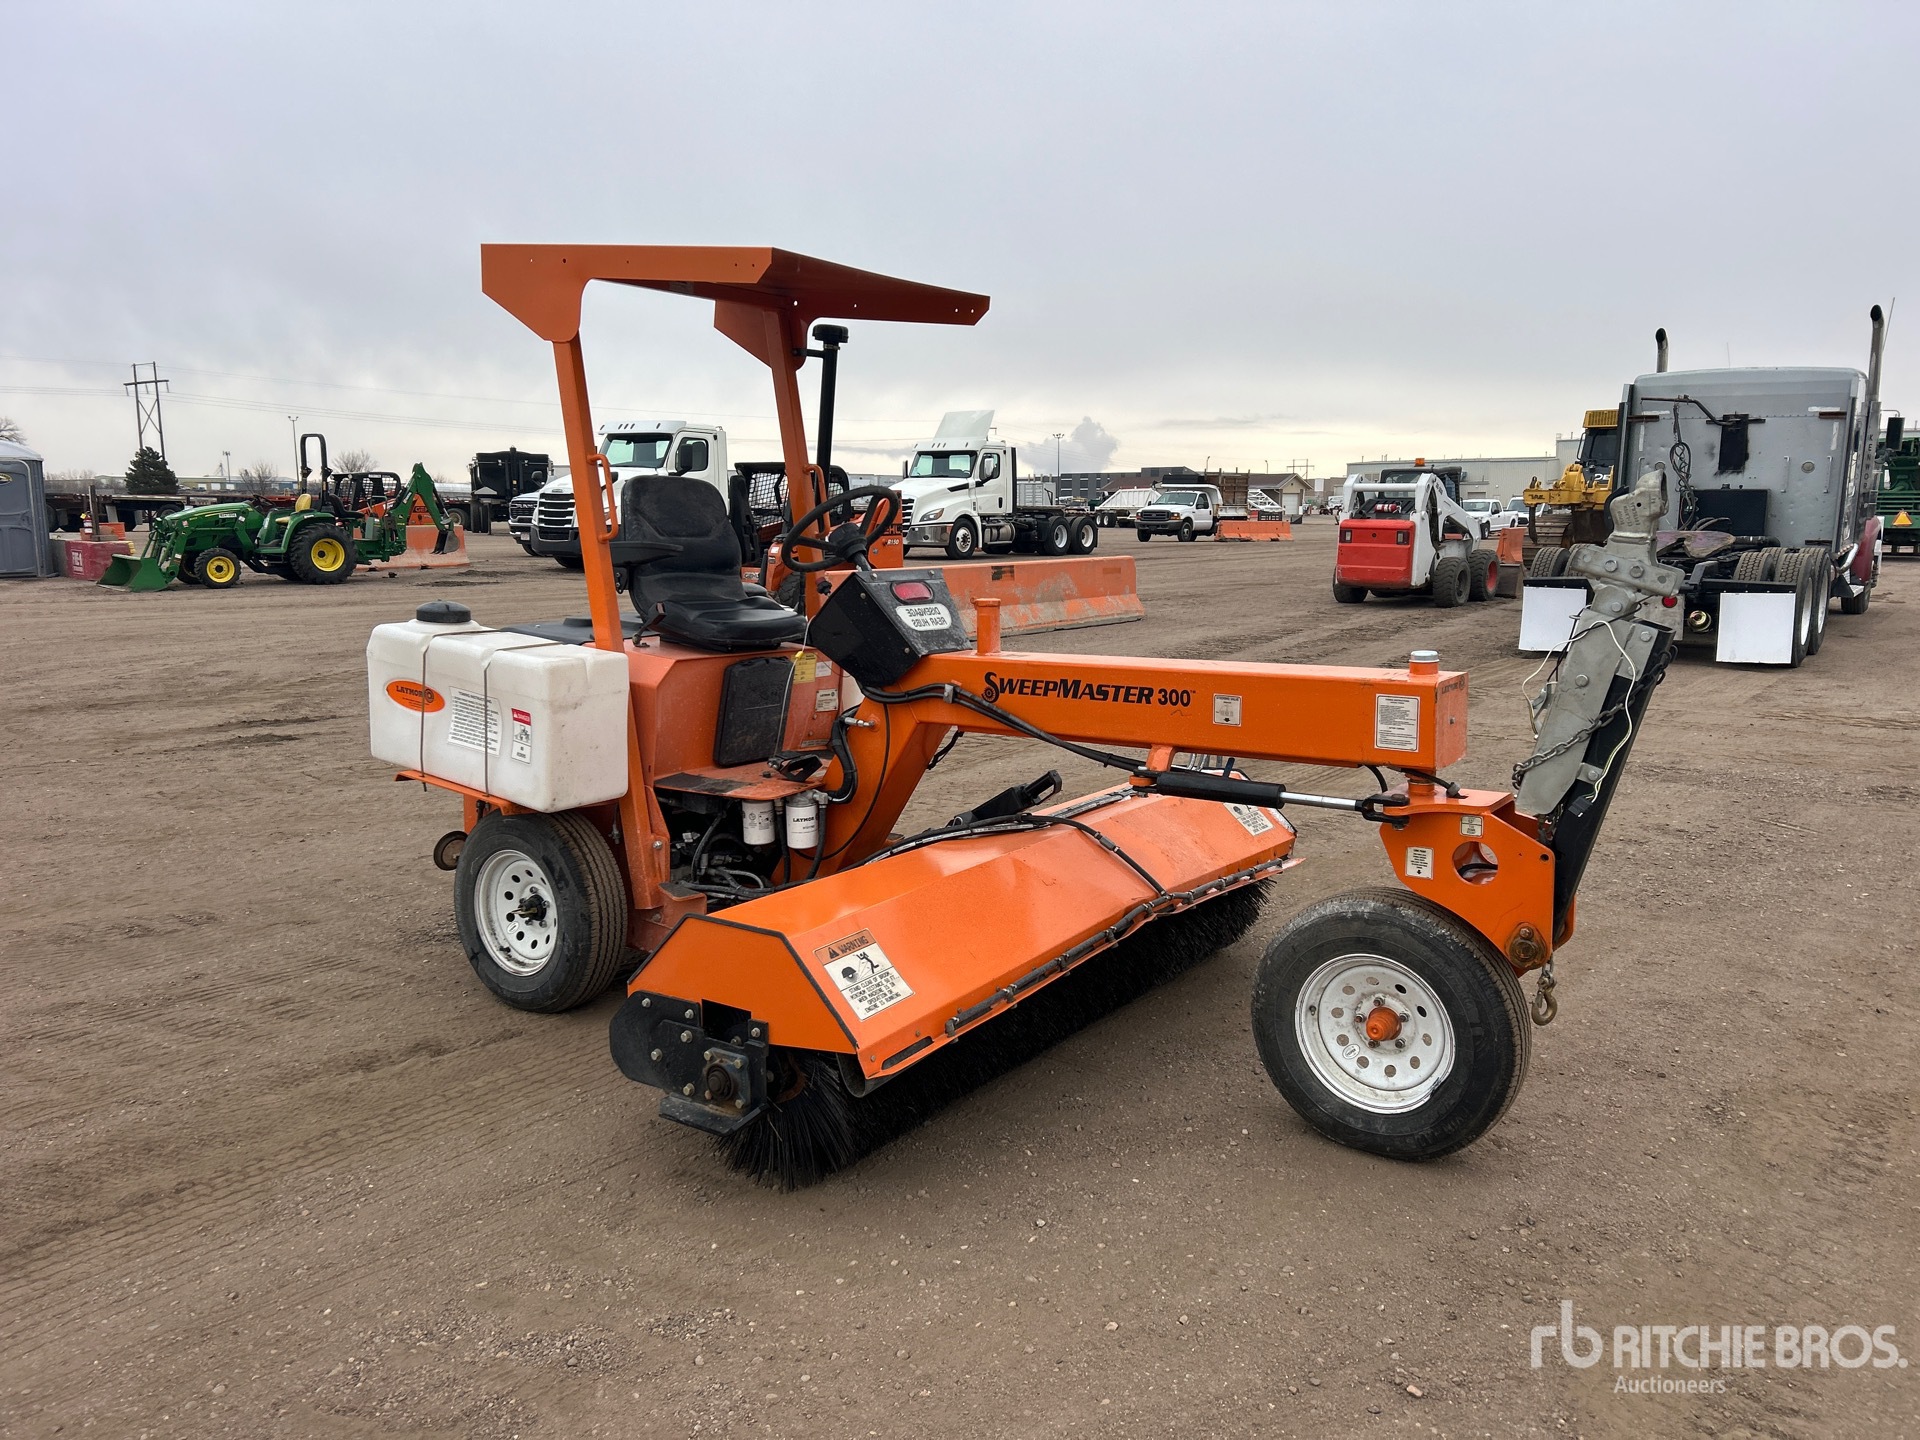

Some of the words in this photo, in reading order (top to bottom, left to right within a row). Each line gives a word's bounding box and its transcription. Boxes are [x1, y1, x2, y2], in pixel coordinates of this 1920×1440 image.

[1863, 434, 1874, 490] KENWOR
[1157, 688, 1191, 707] 300
[838, 936, 869, 954] WARNING
